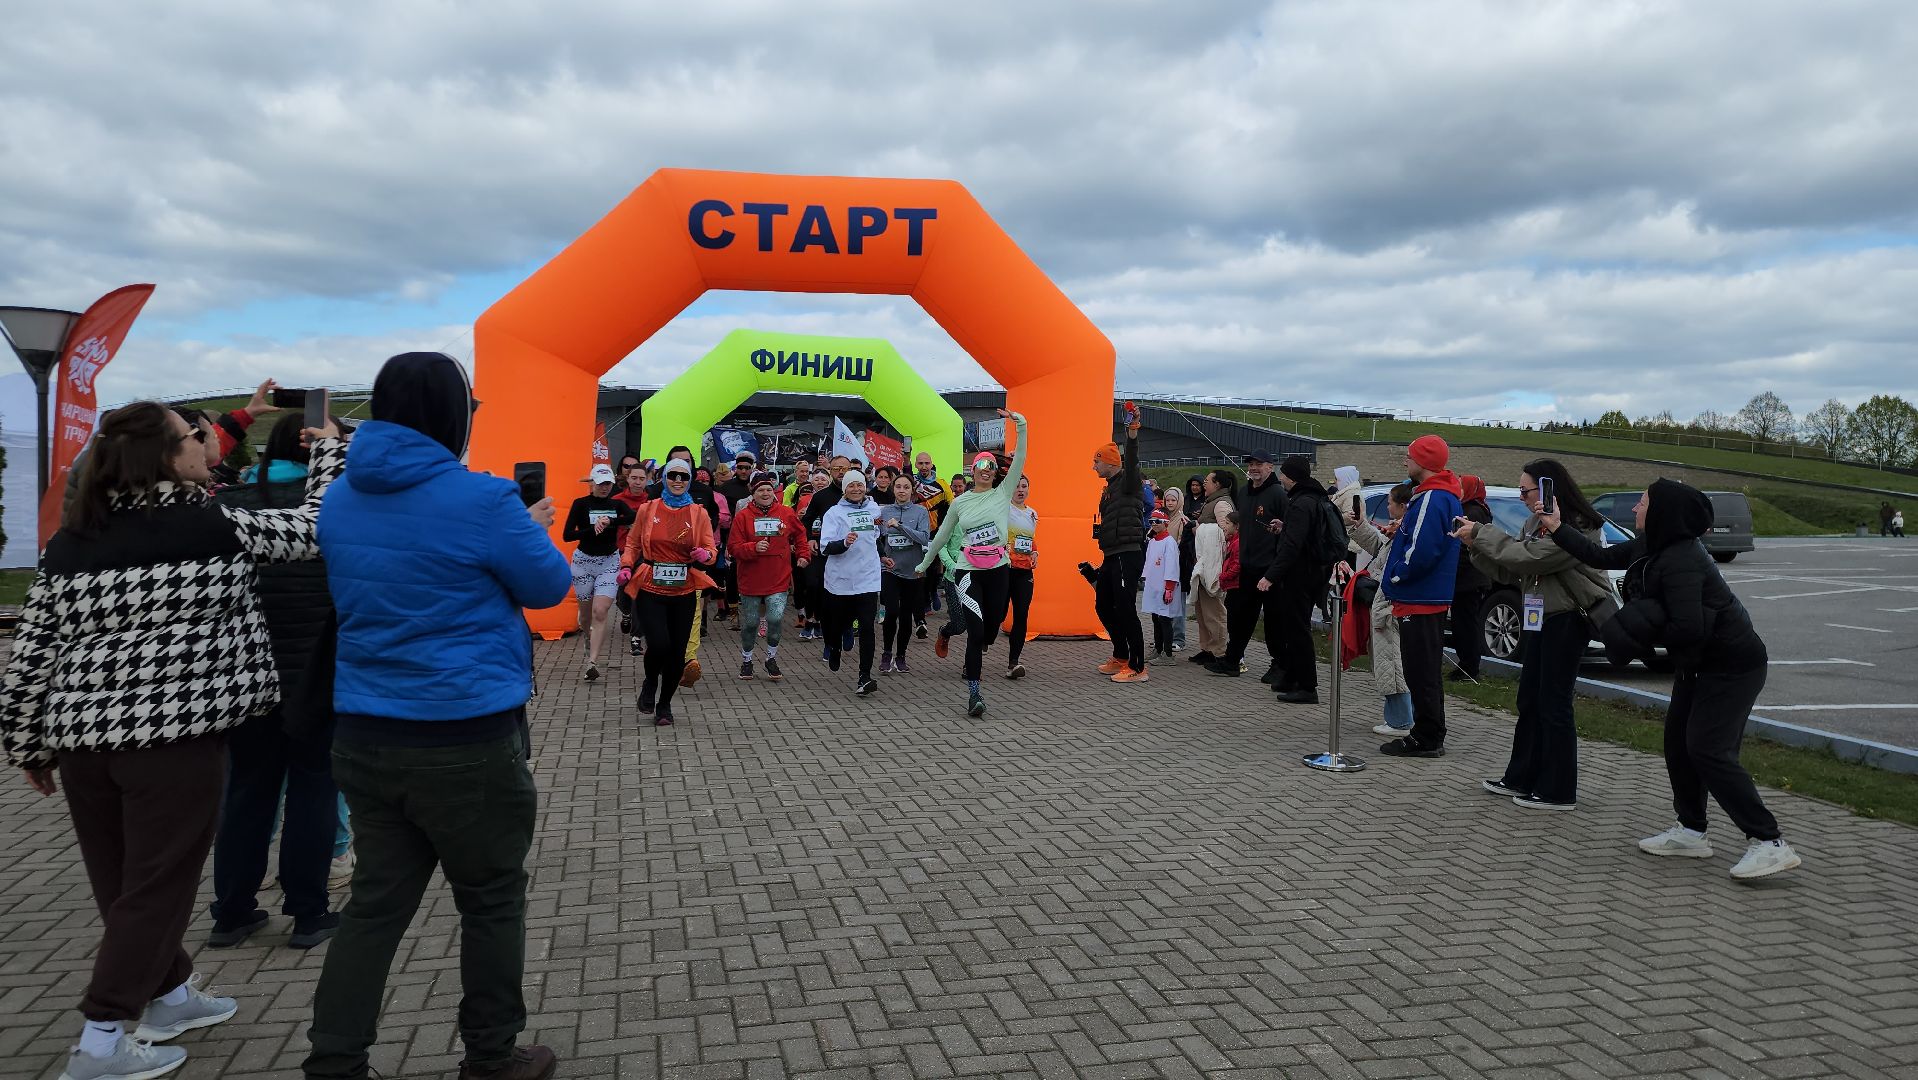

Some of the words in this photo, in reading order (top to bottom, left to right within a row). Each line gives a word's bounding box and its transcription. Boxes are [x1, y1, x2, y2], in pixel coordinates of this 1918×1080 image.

[688, 199, 937, 256] СТАРТ
[750, 348, 874, 382] ФИНИШ
[661, 569, 679, 577] 117
